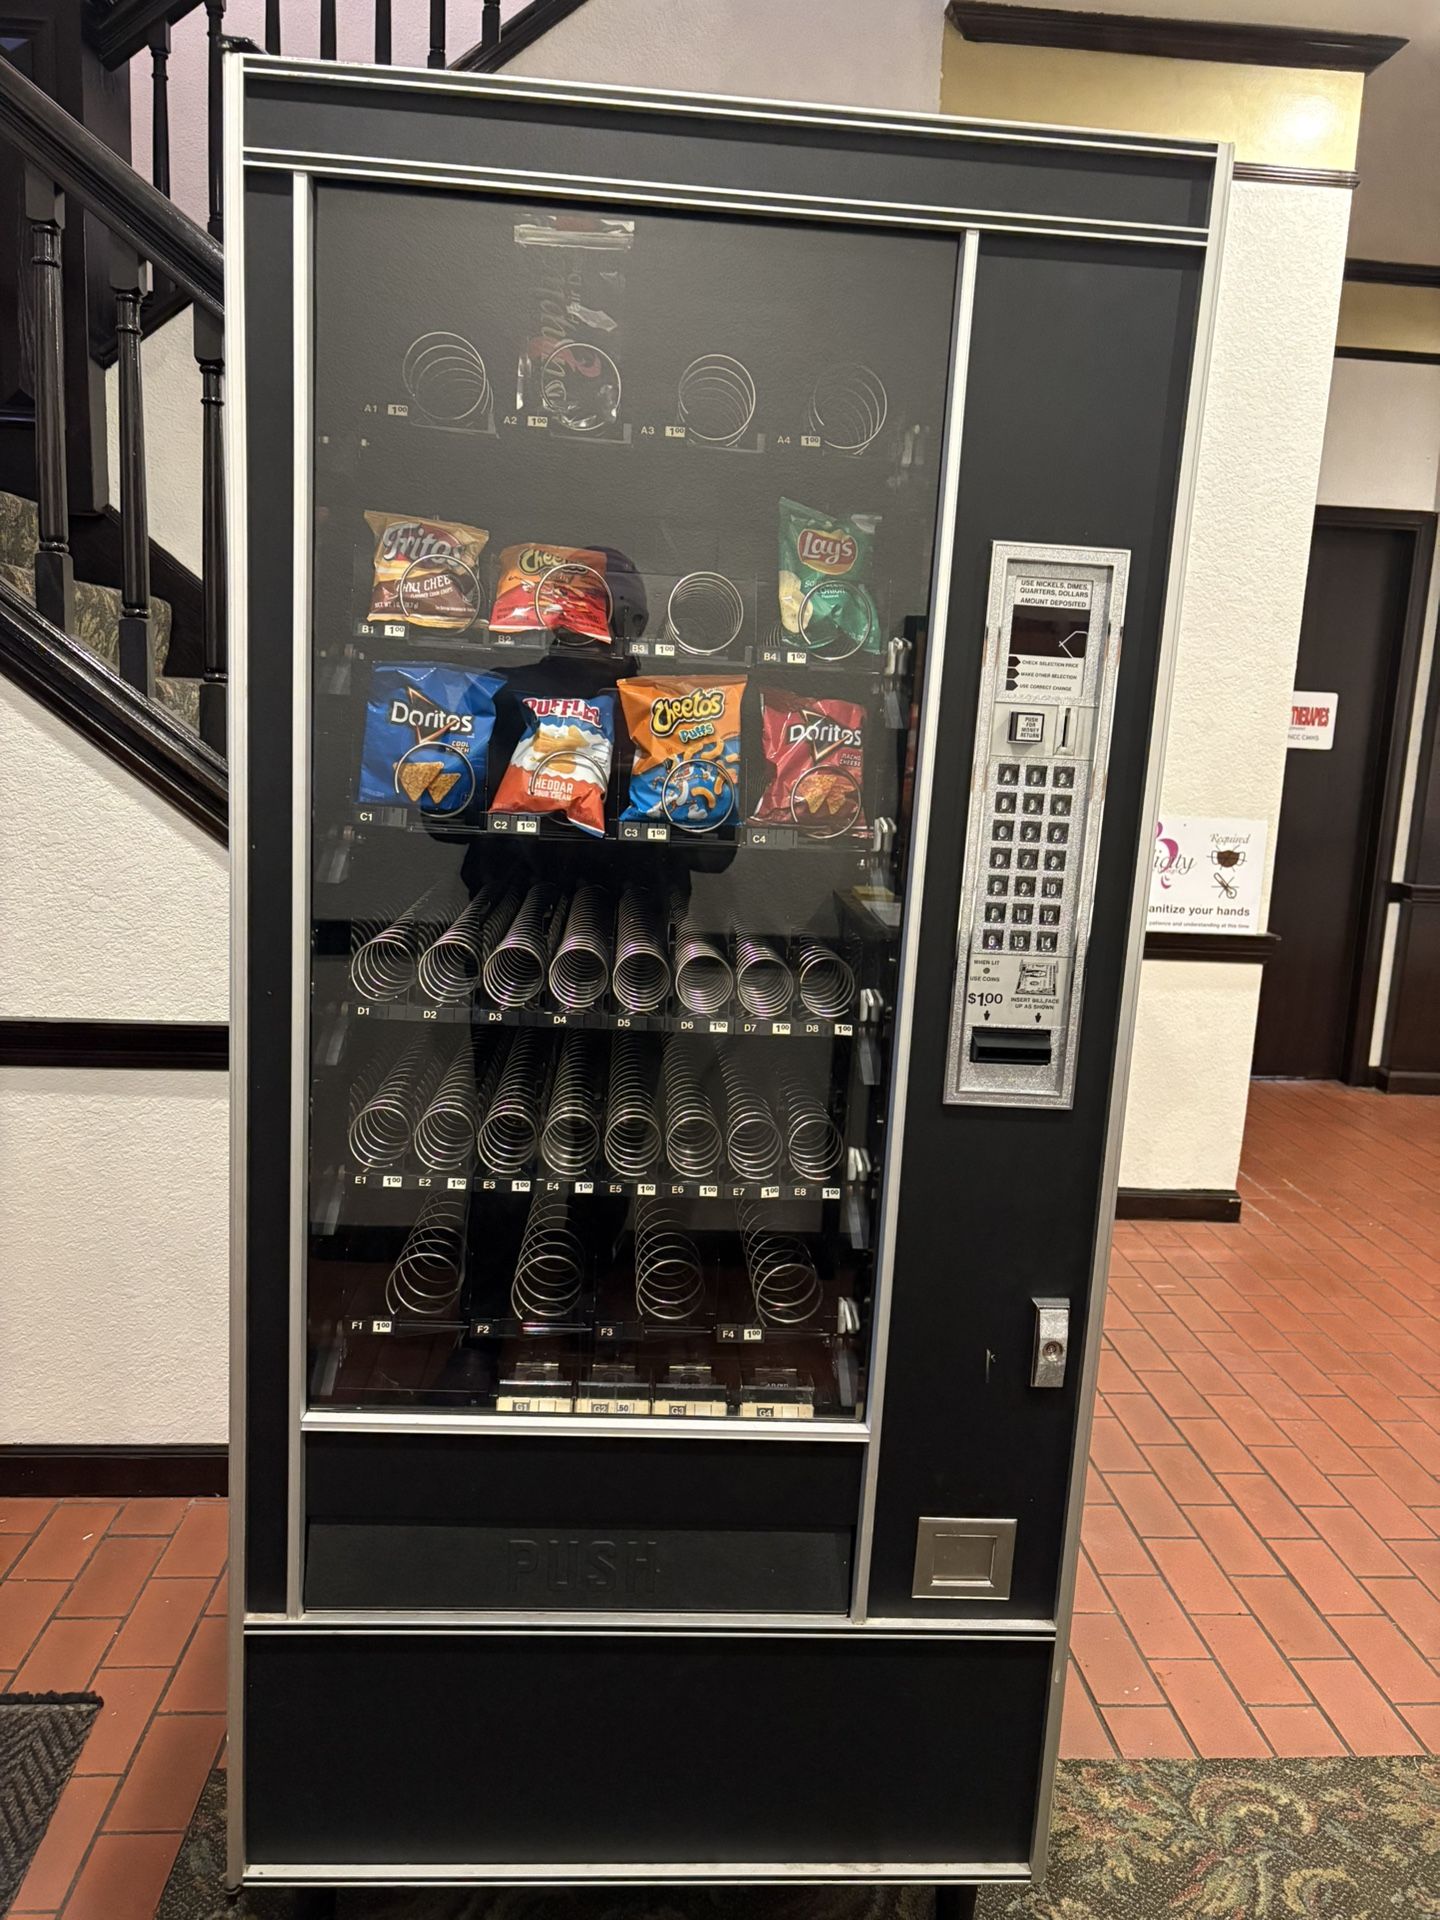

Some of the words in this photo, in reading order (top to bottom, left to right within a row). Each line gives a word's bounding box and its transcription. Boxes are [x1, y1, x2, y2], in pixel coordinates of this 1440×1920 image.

[364, 403, 378, 412] A1
[504, 416, 517, 425] A2
[640, 426, 655, 435] A3
[777, 435, 791, 444] A4
[802, 532, 853, 563] Lay's
[1058, 590, 1089, 598] DOLLARS
[1020, 597, 1049, 605] AMOUNT
[1050, 599, 1087, 608] DEPOSITED
[361, 624, 374, 634] B1
[763, 652, 777, 661] B4
[650, 687, 725, 736] Cheetos
[391, 701, 473, 732] Doritos
[679, 723, 714, 743] Puffs
[789, 723, 862, 746] Doritos
[360, 812, 373, 821] C1
[494, 820, 508, 830] C2
[624, 828, 638, 837] C3
[752, 834, 766, 844] C4
[1148, 904, 1185, 914] anitize
[1188, 907, 1213, 916] your
[1216, 906, 1250, 916] hands
[968, 992, 1004, 1006] $1.00
[358, 1006, 370, 1015] D1
[423, 1010, 437, 1019] D2
[489, 1012, 502, 1021] D3
[553, 1015, 567, 1024] D4
[617, 1018, 631, 1027] D5
[681, 1021, 694, 1030] D6
[744, 1024, 757, 1032] D7
[806, 1024, 819, 1033] D8
[354, 1176, 367, 1184] E1
[418, 1178, 431, 1187] E2
[483, 1181, 496, 1190] E3
[547, 1182, 560, 1191] E4
[610, 1185, 622, 1193] E5
[672, 1186, 684, 1194] E6
[733, 1187, 745, 1196] E7
[794, 1187, 807, 1196] E8
[352, 1321, 363, 1330] F1
[477, 1325, 489, 1334] F2
[601, 1328, 613, 1336] F3
[723, 1330, 734, 1338] F4
[516, 1403, 528, 1411] G1
[671, 1406, 684, 1415] G3
[759, 1408, 772, 1417] G4
[509, 1539, 658, 1593] PUSH
